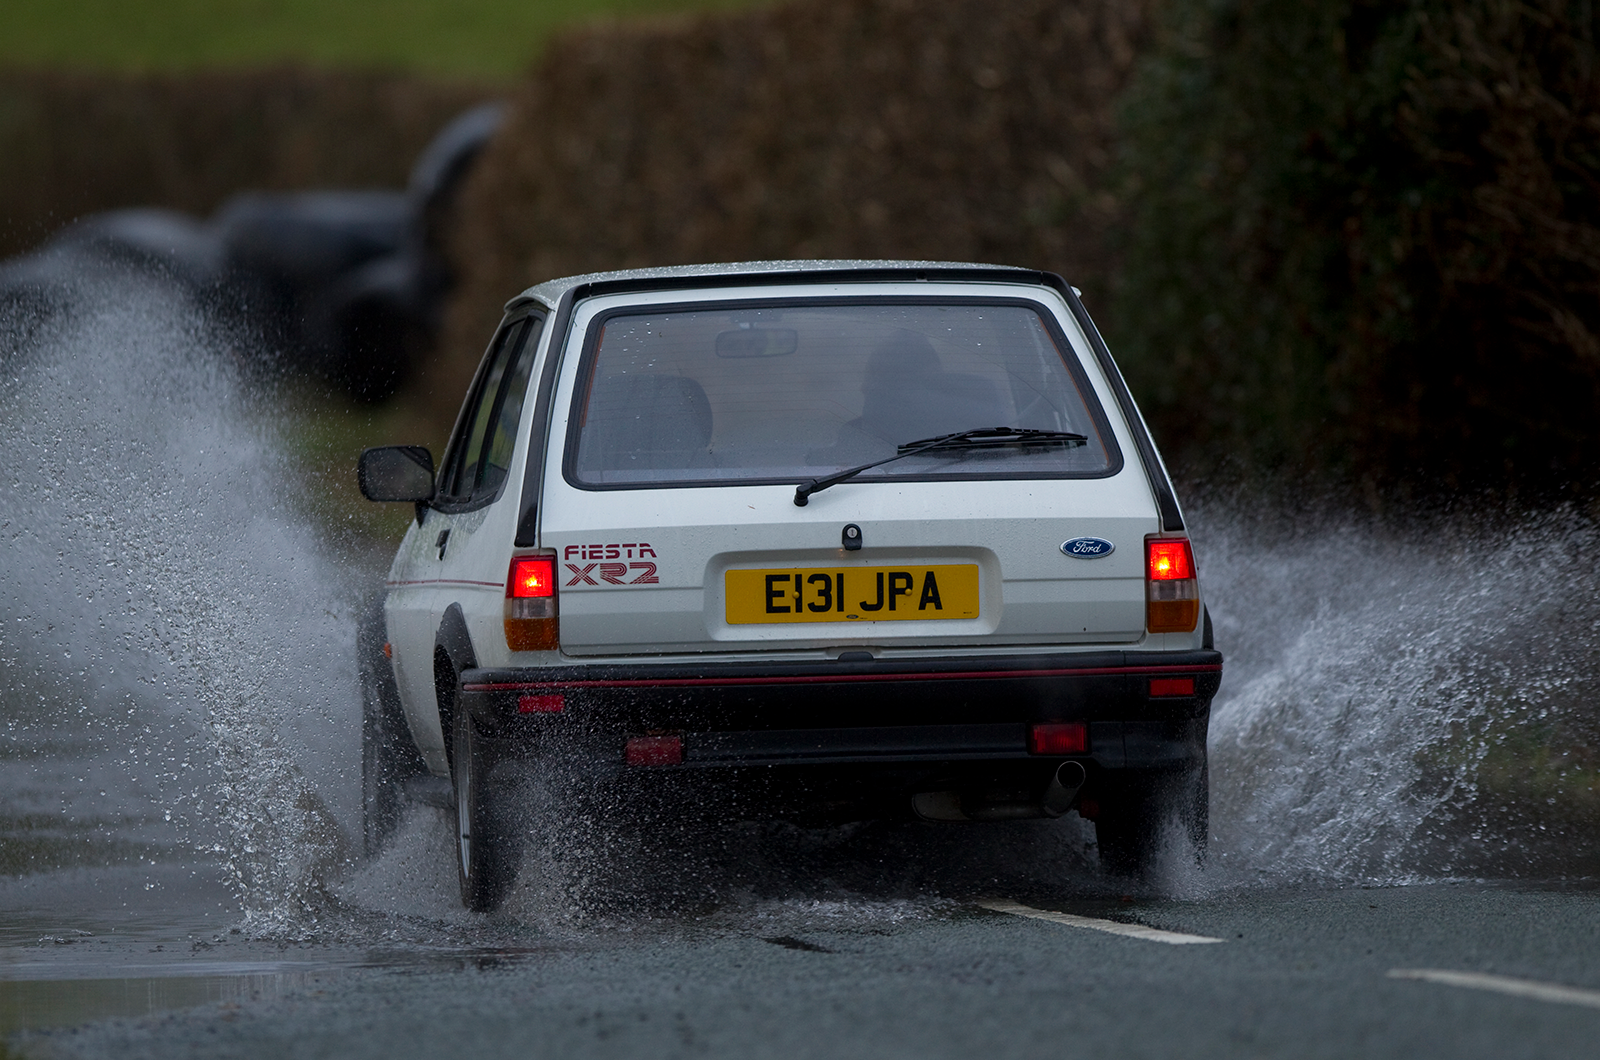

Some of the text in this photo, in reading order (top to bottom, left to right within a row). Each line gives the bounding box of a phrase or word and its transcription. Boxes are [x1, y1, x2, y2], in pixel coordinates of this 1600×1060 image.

[1072, 540, 1102, 553] Ford
[564, 561, 659, 586] XR2
[765, 571, 943, 613] E131 JPA
